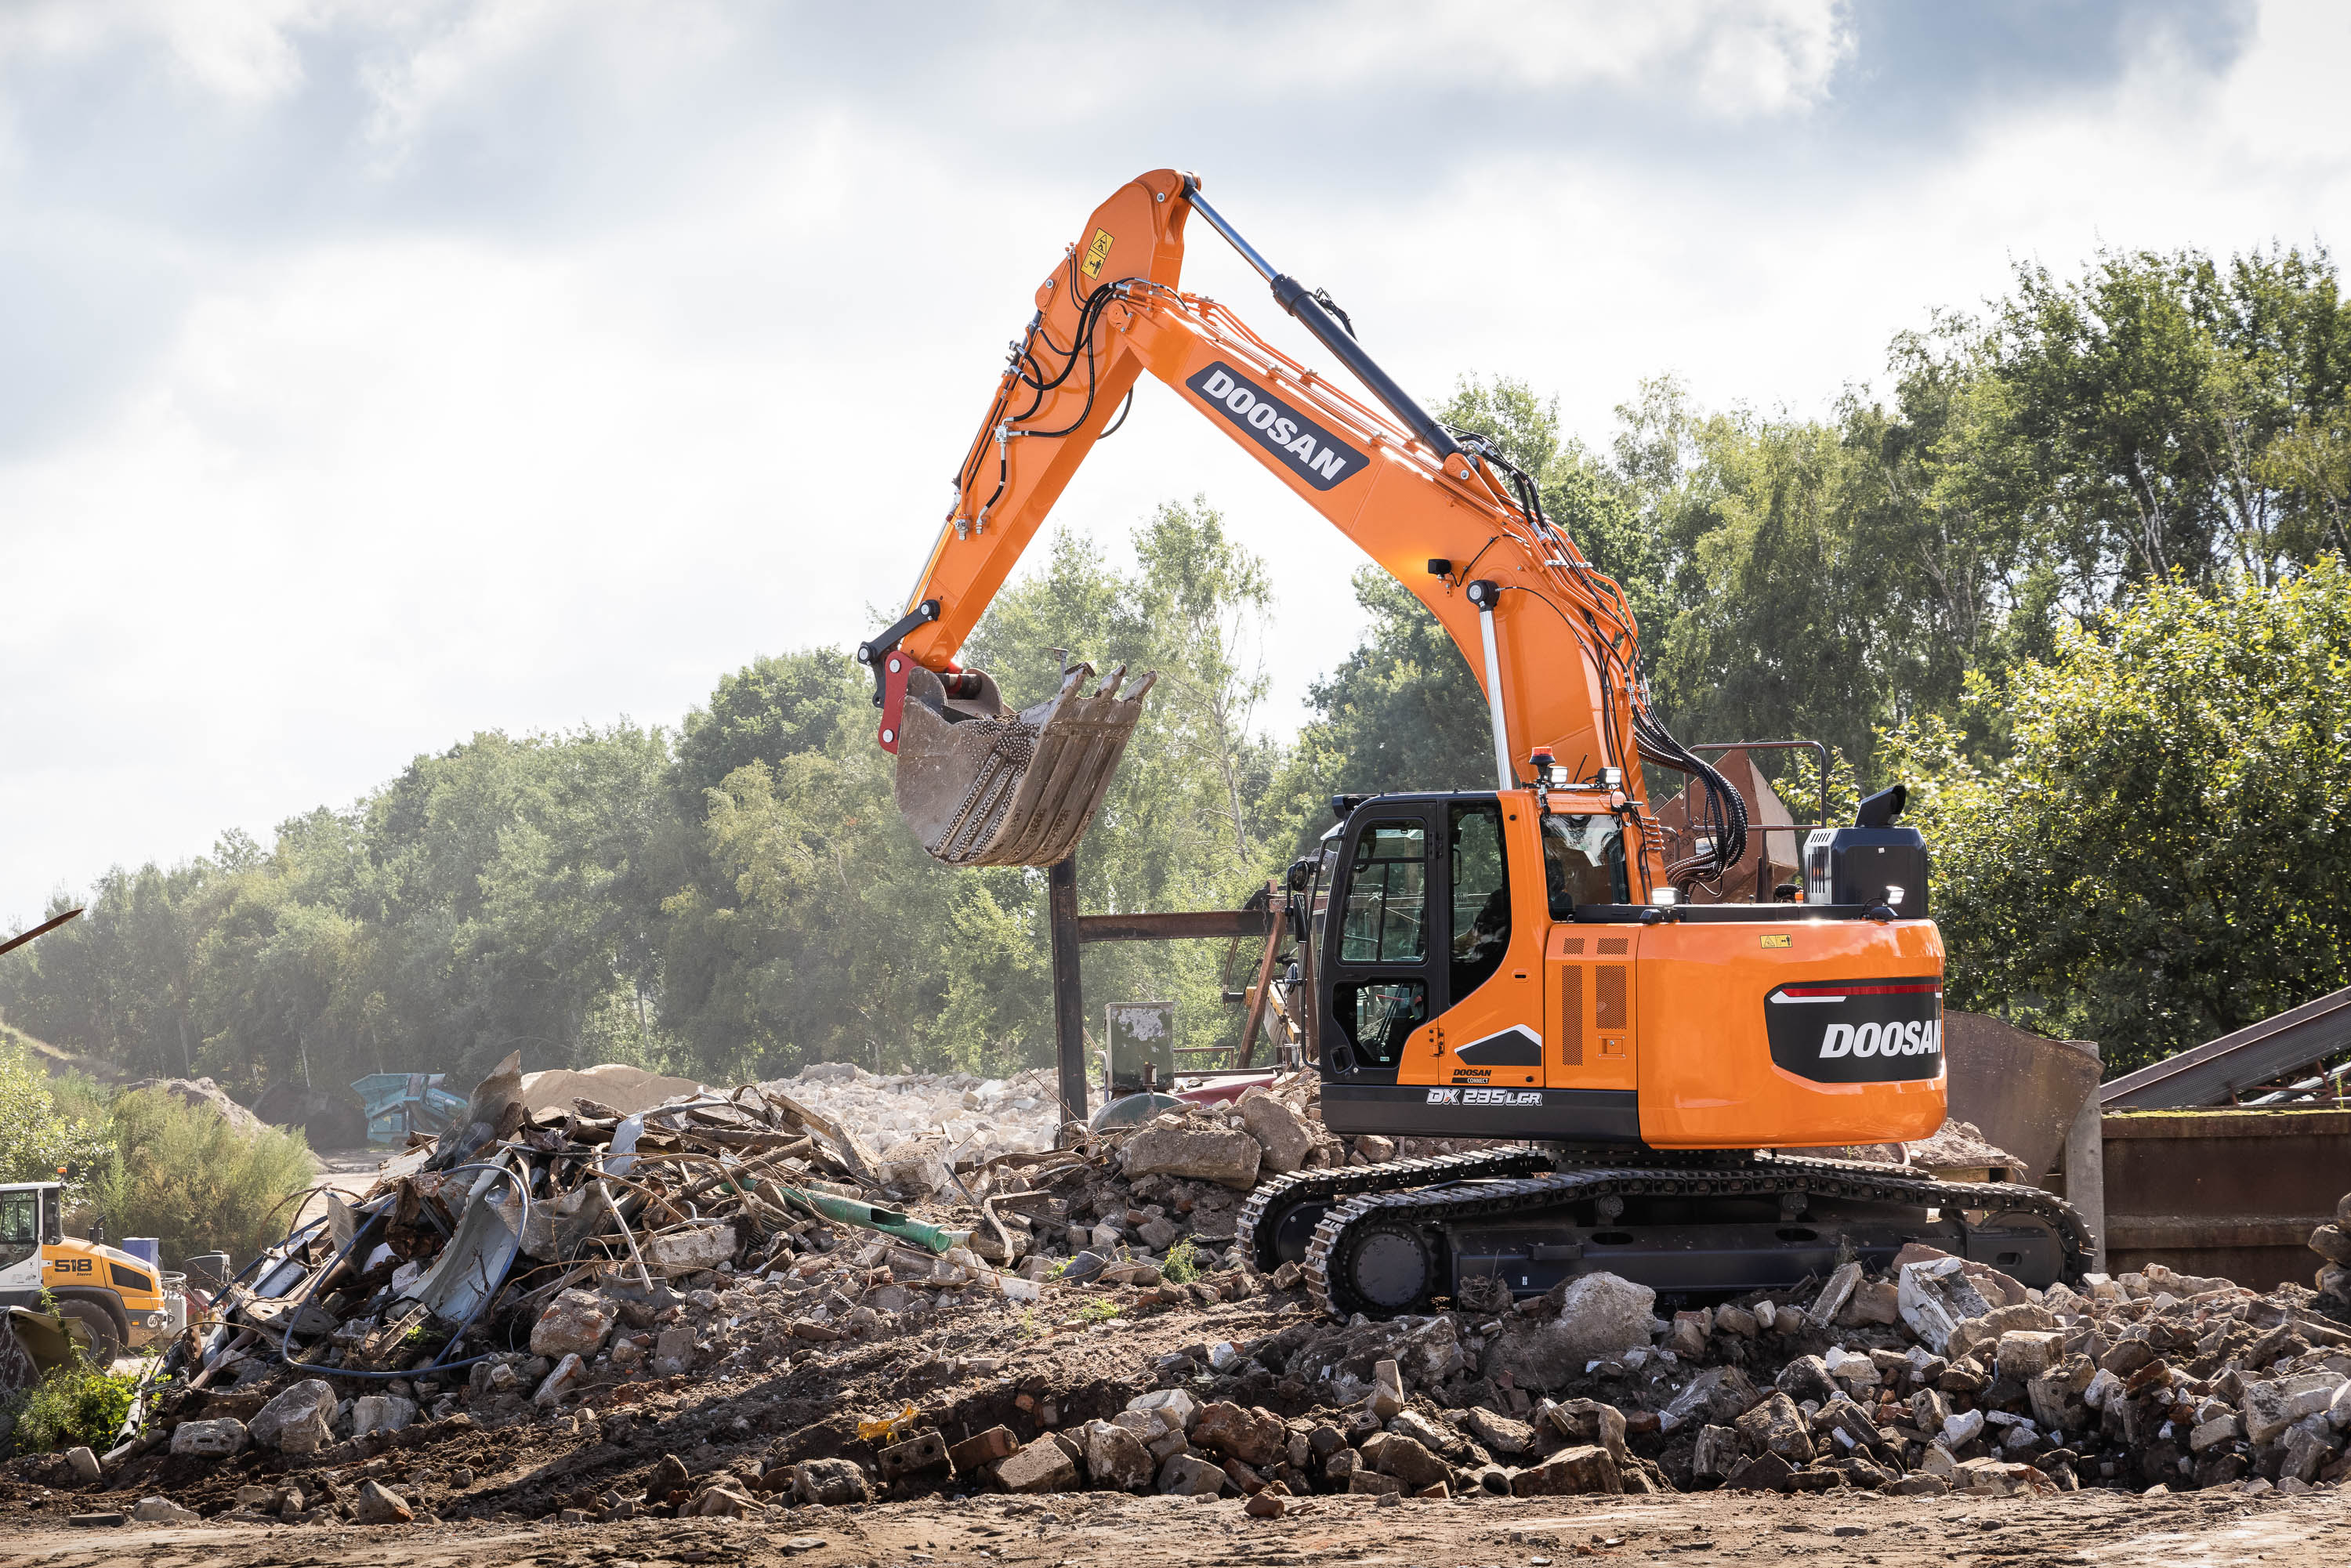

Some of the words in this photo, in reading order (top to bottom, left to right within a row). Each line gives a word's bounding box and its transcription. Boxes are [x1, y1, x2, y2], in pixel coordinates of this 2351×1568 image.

[1201, 369, 1347, 481] DOOSAN
[1819, 1019, 1942, 1058] DOOSAN
[1426, 1088, 1461, 1106] DX
[1462, 1088, 1543, 1106] 235LCR
[54, 1258, 92, 1273] 518
